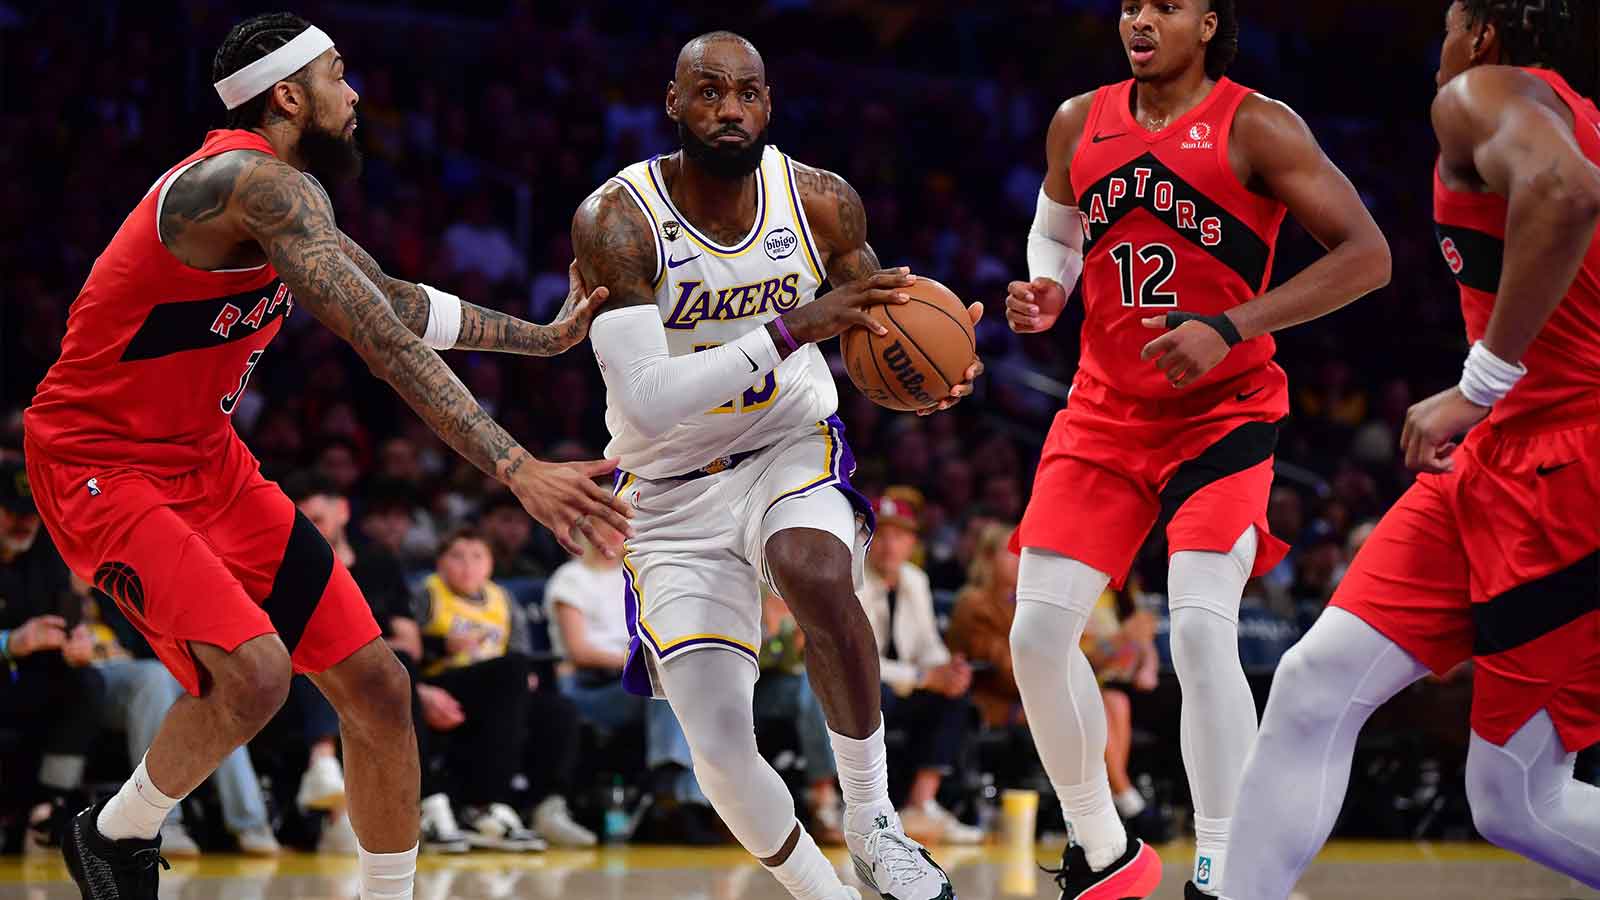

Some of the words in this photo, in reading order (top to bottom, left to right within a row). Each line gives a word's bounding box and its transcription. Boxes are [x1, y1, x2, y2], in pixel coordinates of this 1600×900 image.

[1180, 141, 1197, 150] Sun
[1197, 141, 1213, 150] Life
[766, 236, 795, 250] bibigo
[1109, 242, 1178, 308] 12
[663, 272, 800, 330] LAKERS
